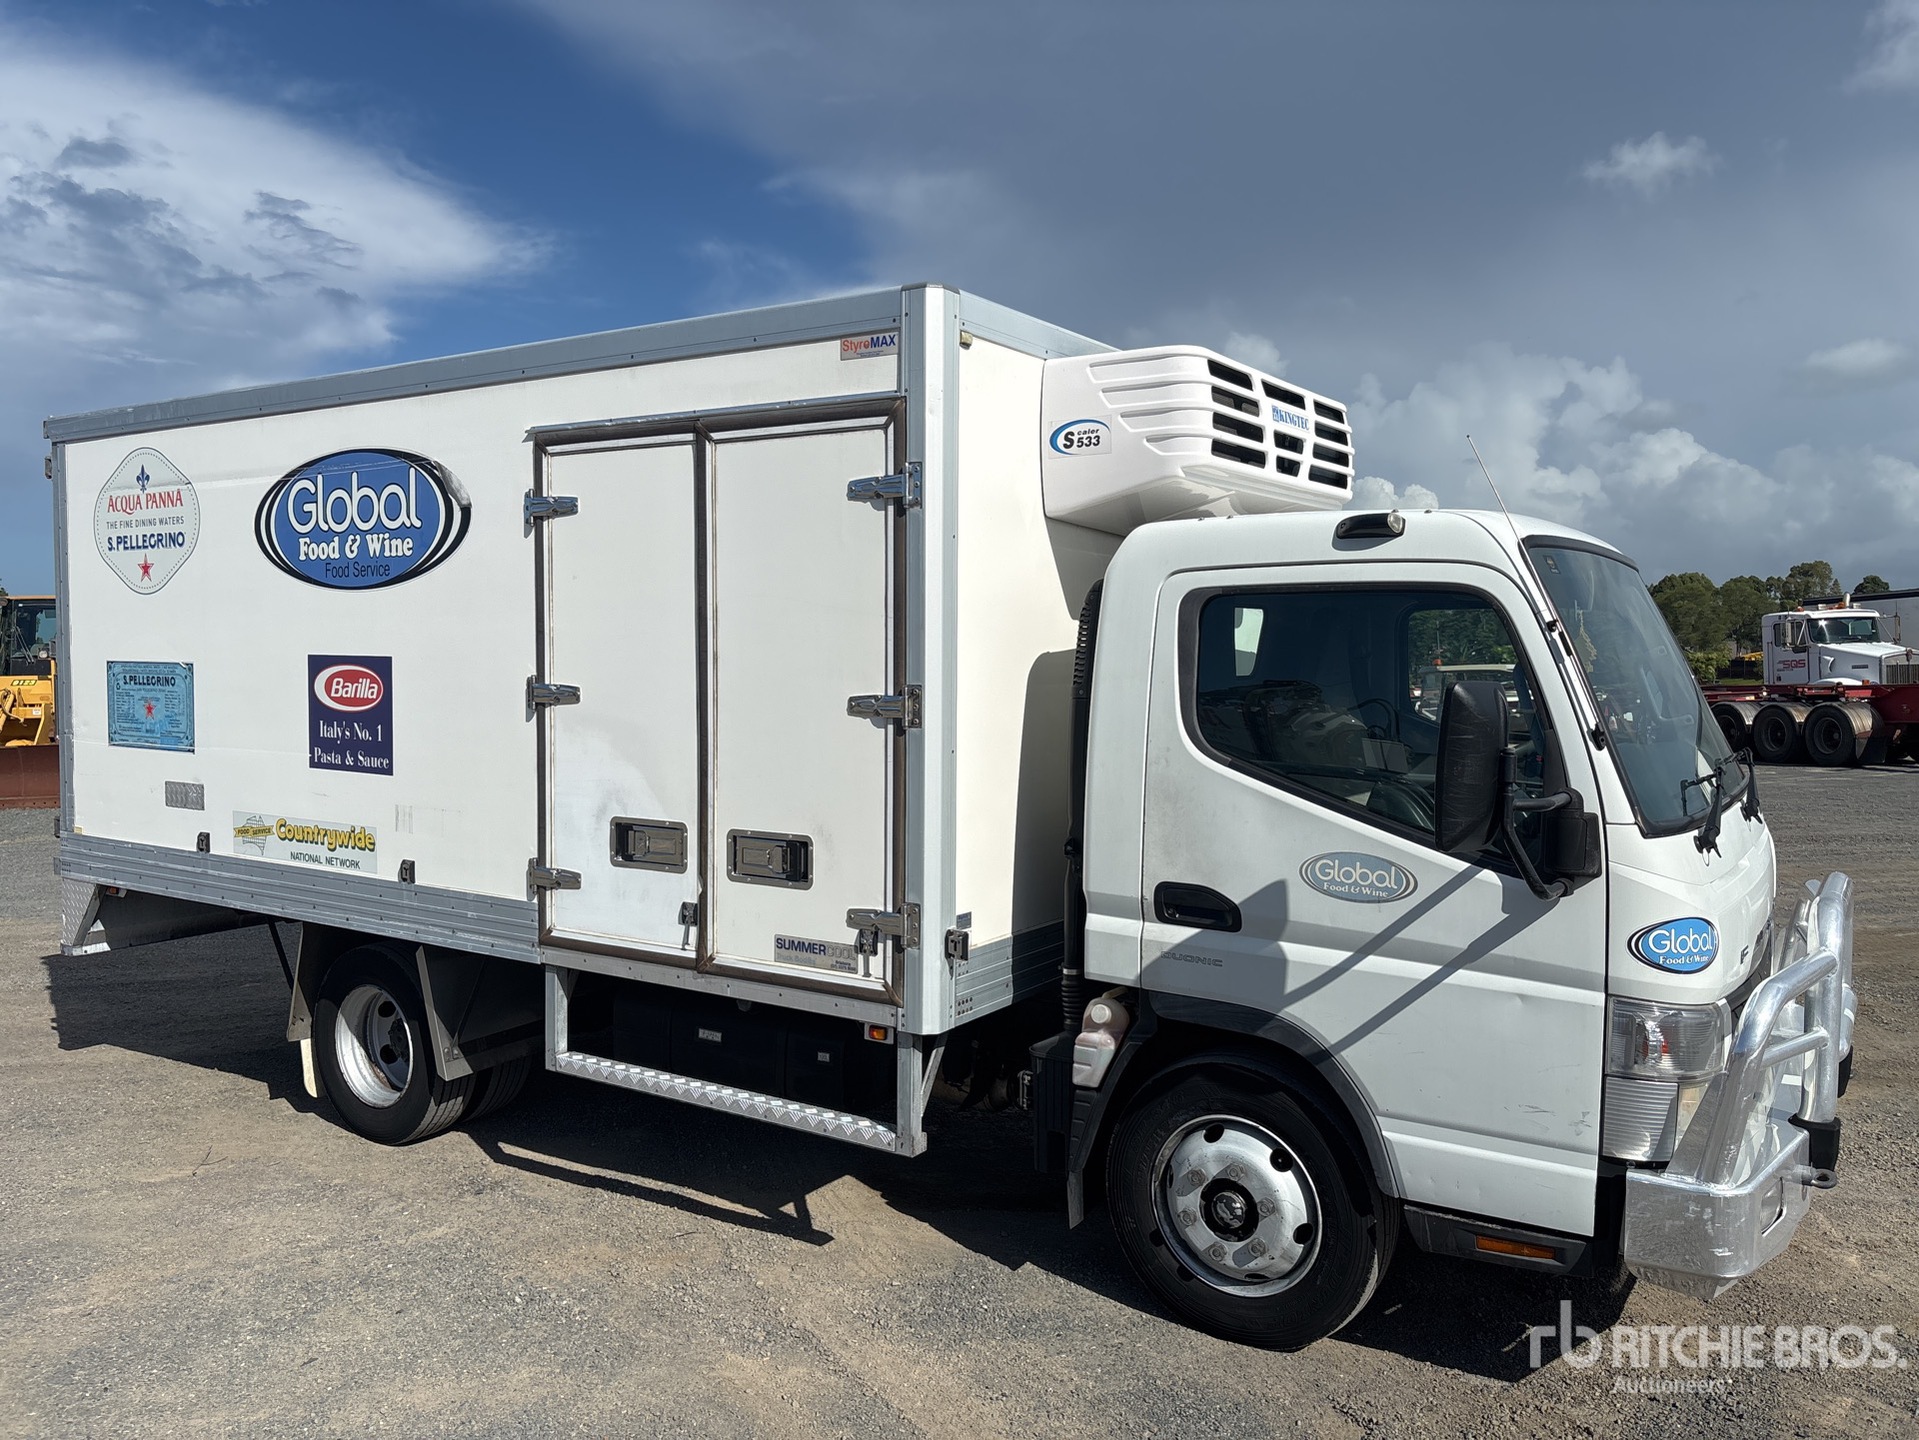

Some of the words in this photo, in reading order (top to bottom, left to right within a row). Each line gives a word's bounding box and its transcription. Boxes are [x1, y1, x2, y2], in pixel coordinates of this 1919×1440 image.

[107, 495, 143, 515] ACQUA
[145, 488, 184, 509] PANNA
[287, 467, 422, 534] Global
[106, 520, 117, 530] THE
[119, 519, 134, 529] FINE
[135, 518, 157, 528] DINING
[158, 515, 185, 526] WATERS
[299, 536, 340, 561] Food
[345, 534, 360, 559] &
[366, 532, 414, 558] Wine
[325, 562, 350, 579] Food
[352, 561, 391, 578] Service
[330, 678, 379, 699] Barilla
[319, 720, 351, 744] Italy's
[353, 722, 372, 741] No.
[376, 724, 382, 741] 1
[314, 747, 341, 765] Pasta
[345, 750, 354, 766] &
[358, 750, 390, 769] Sauce
[276, 818, 376, 852] Countrywide
[290, 851, 323, 864] NATIONAL
[325, 856, 361, 869] NETWORK
[1315, 859, 1398, 889] Global
[1323, 882, 1348, 892] Food
[1361, 887, 1389, 898] Wine
[1648, 926, 1713, 954] Global
[1659, 955, 1685, 965] Food
